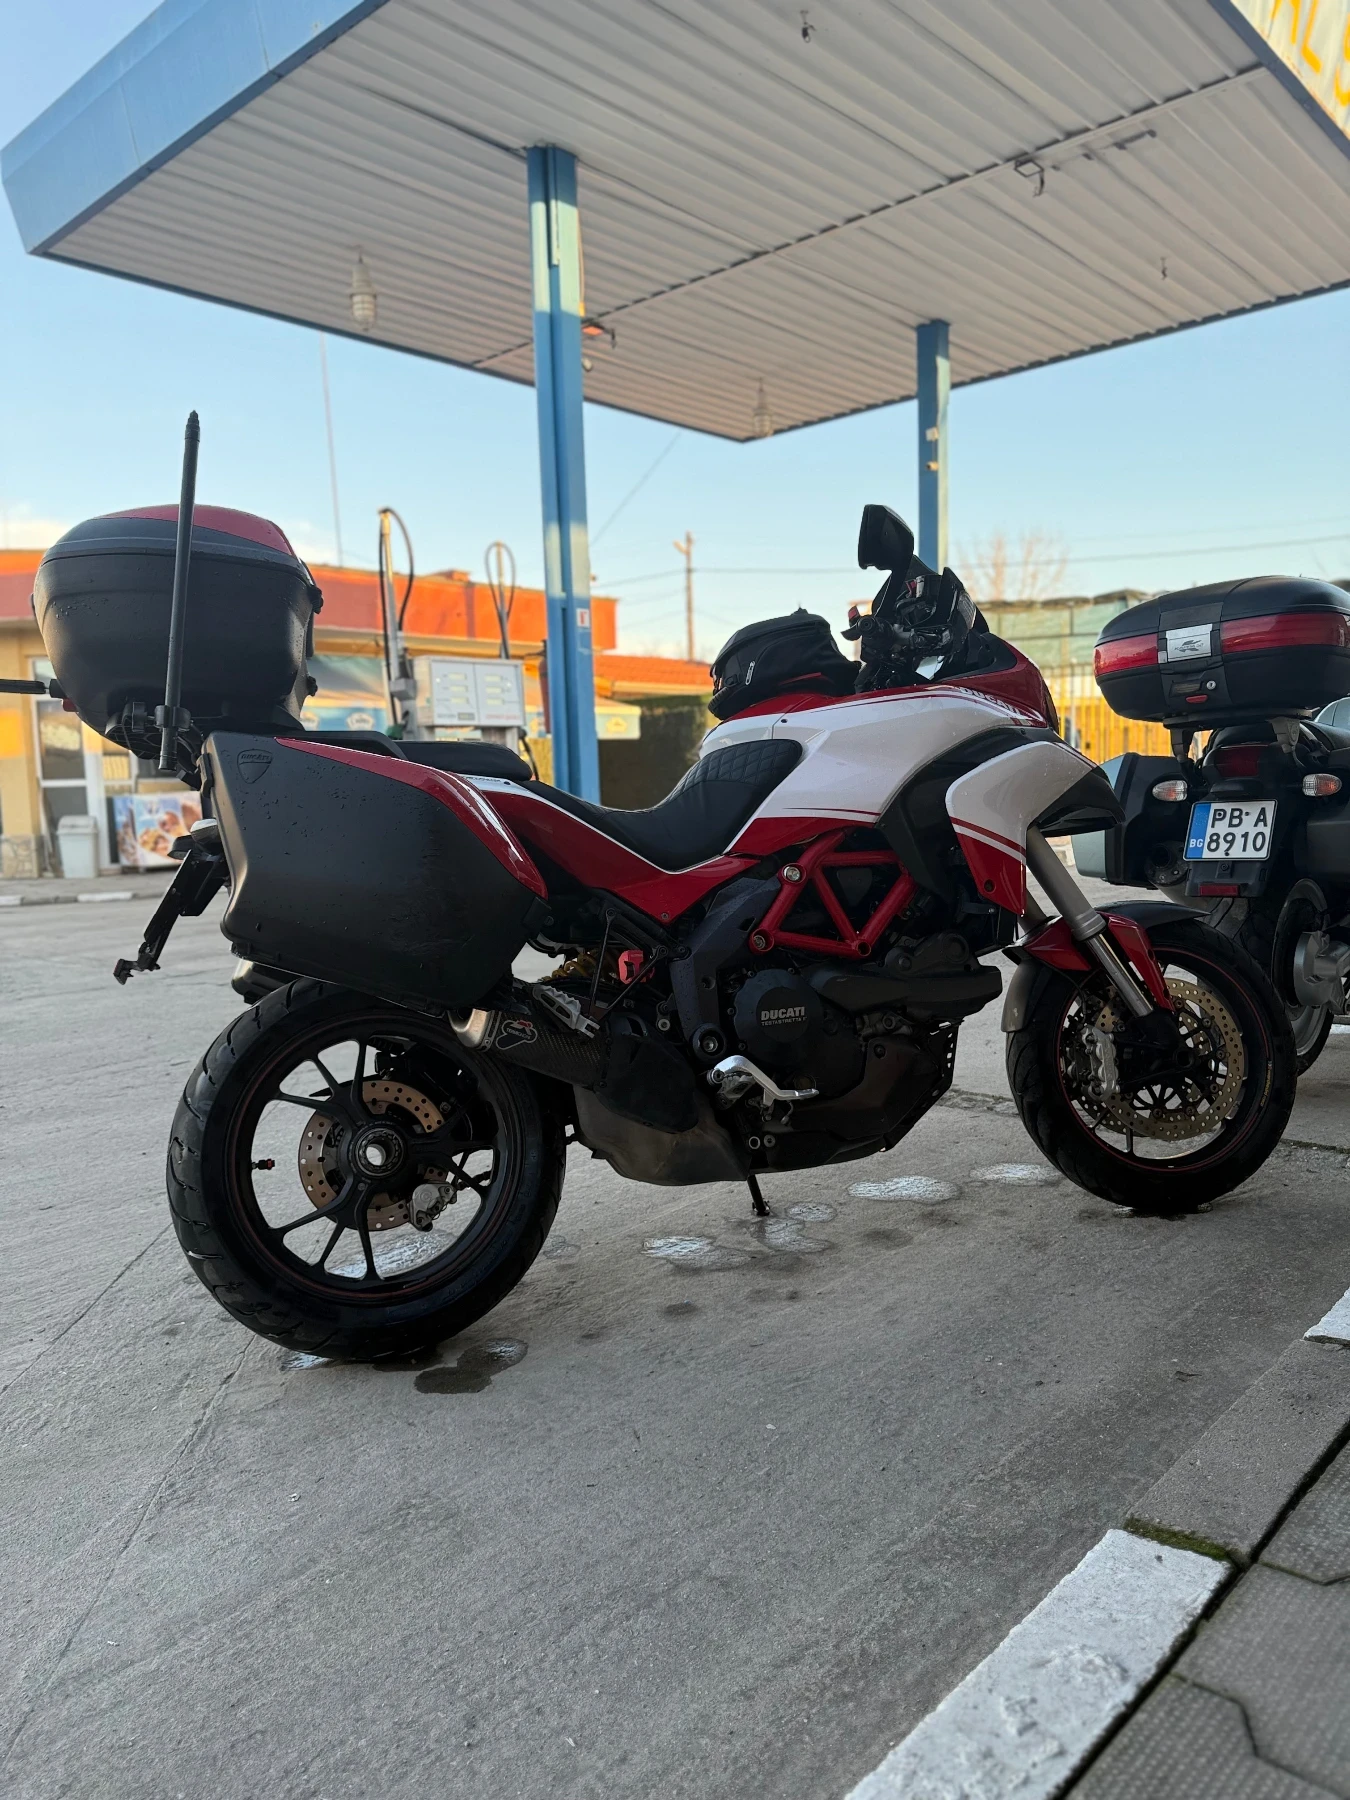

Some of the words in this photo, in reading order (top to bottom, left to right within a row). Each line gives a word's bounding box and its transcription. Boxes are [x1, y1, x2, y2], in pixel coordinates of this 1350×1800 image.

[960, 687, 1021, 715] DUCATI
[1210, 808, 1243, 829] PB
[1253, 807, 1268, 828] A
[1189, 838, 1204, 848] BG
[1206, 831, 1267, 853] 8910
[761, 1006, 805, 1021] DUCATI
